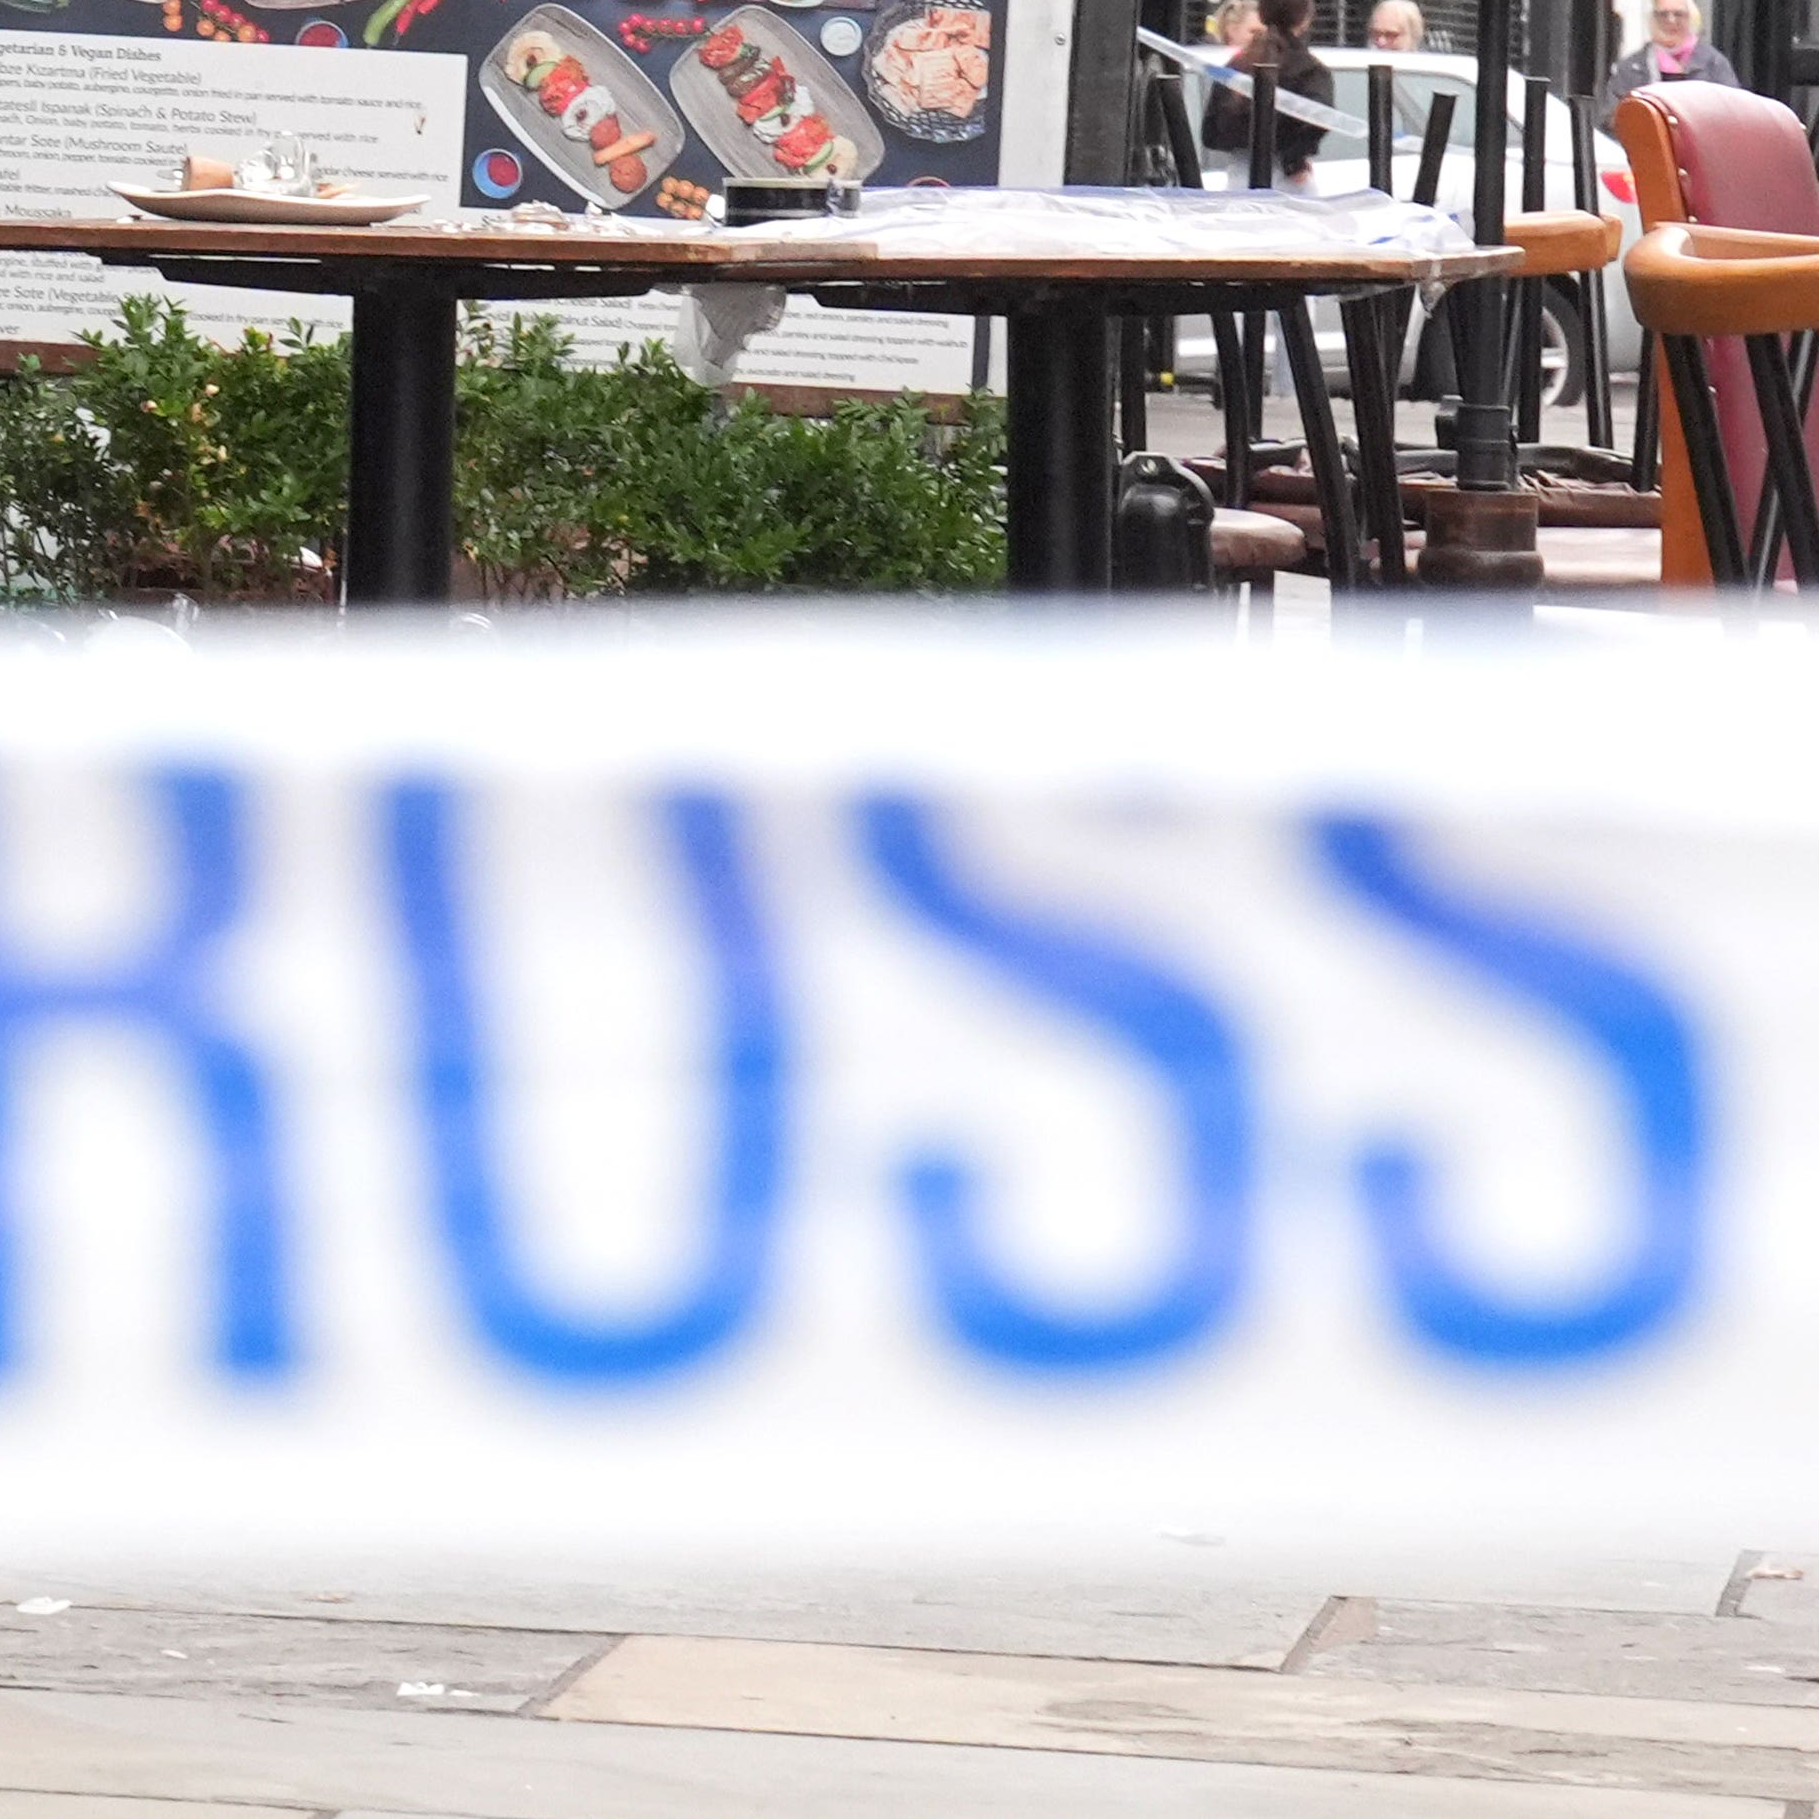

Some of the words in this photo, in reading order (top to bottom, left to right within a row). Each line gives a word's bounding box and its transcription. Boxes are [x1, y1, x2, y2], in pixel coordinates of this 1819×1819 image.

[70, 45, 114, 63] Vegan
[116, 47, 162, 62] Dishes
[94, 103, 153, 120] (Spinach
[156, 107, 167, 120] &
[170, 108, 215, 123] Potato
